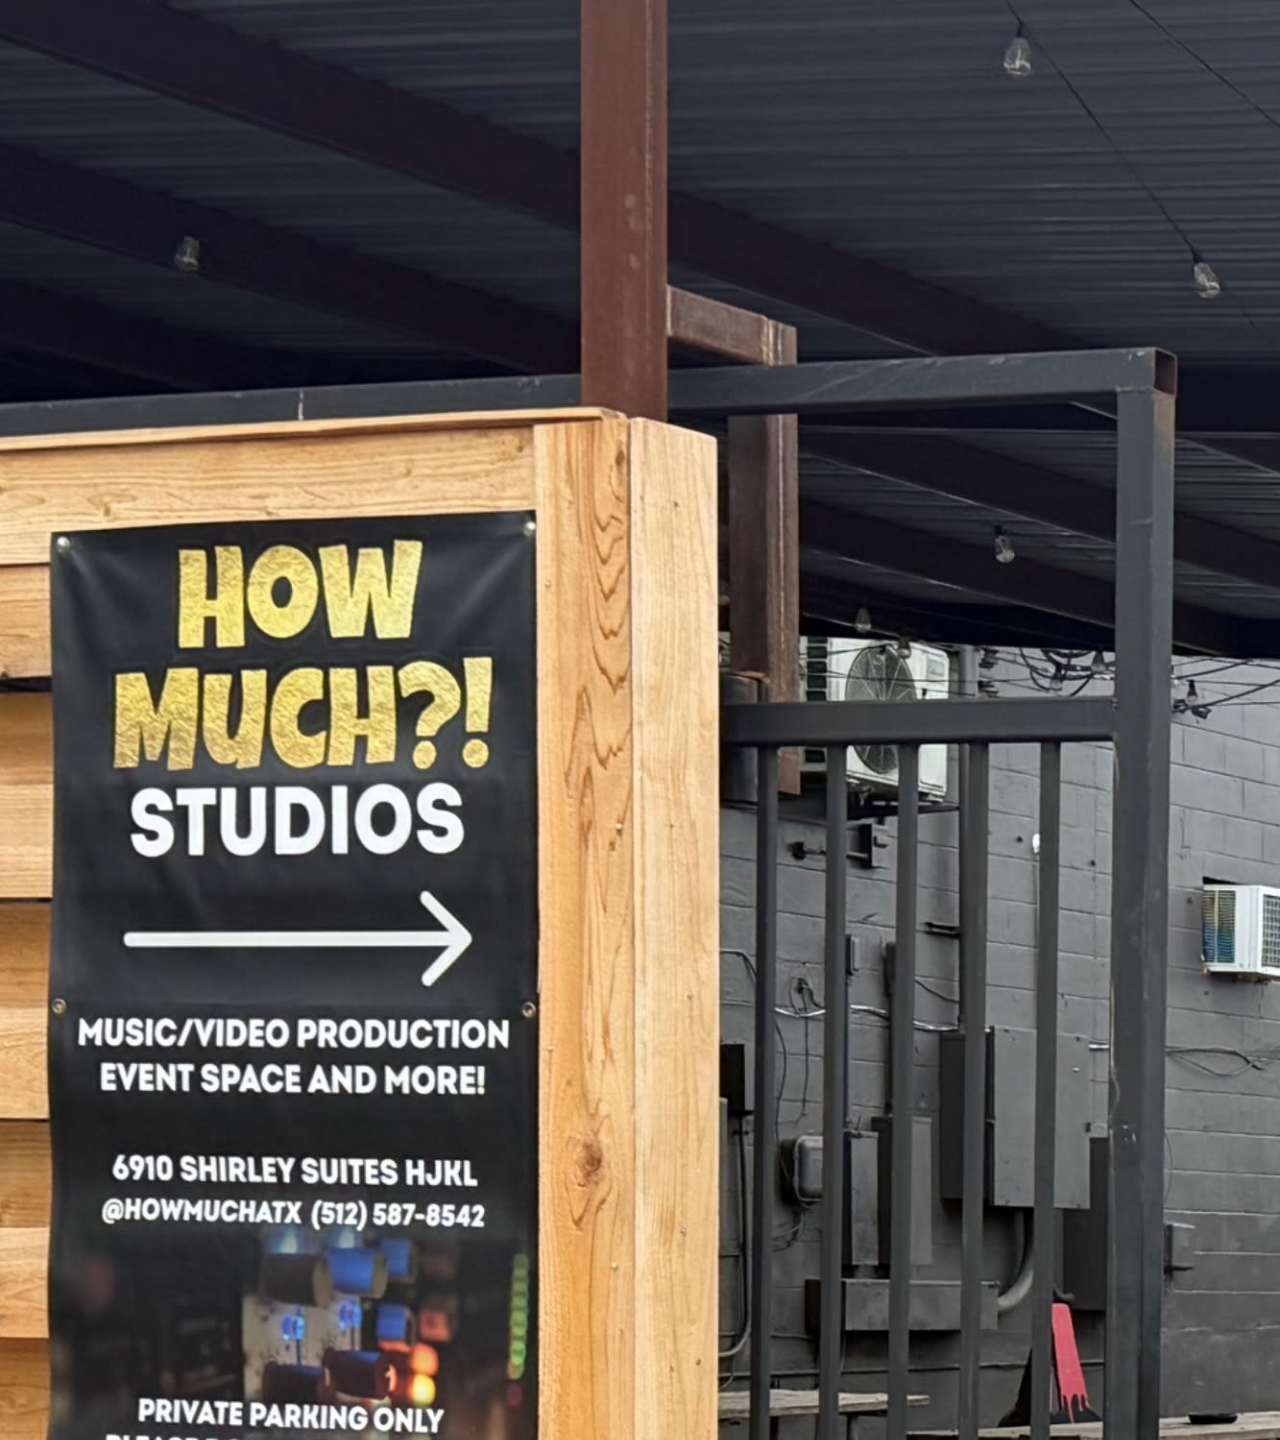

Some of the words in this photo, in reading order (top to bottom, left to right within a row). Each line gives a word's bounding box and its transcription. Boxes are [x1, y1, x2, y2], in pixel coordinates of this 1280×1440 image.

[179, 539, 423, 648] HOW
[113, 656, 492, 771] MUCH?!
[130, 782, 465, 857] STUDIOS
[78, 1017, 290, 1049] MUSIC/VIDEO
[297, 1019, 510, 1050] PRODUCTION
[100, 1062, 194, 1091] EVENT
[201, 1063, 301, 1093] SPACE
[307, 1064, 377, 1094] AND
[385, 1065, 486, 1095] MORE!
[112, 1154, 173, 1182] 6910
[180, 1156, 295, 1184] SHIRLEY
[301, 1157, 398, 1185] SUITES
[405, 1159, 478, 1187] HJKL
[101, 1198, 301, 1226] @HOWMUCHATX
[311, 1200, 367, 1231] (512)
[373, 1203, 485, 1228] 587-8542
[138, 1398, 243, 1426] PRIVATE
[249, 1403, 368, 1431] PARKING
[373, 1407, 444, 1434] ONLY
